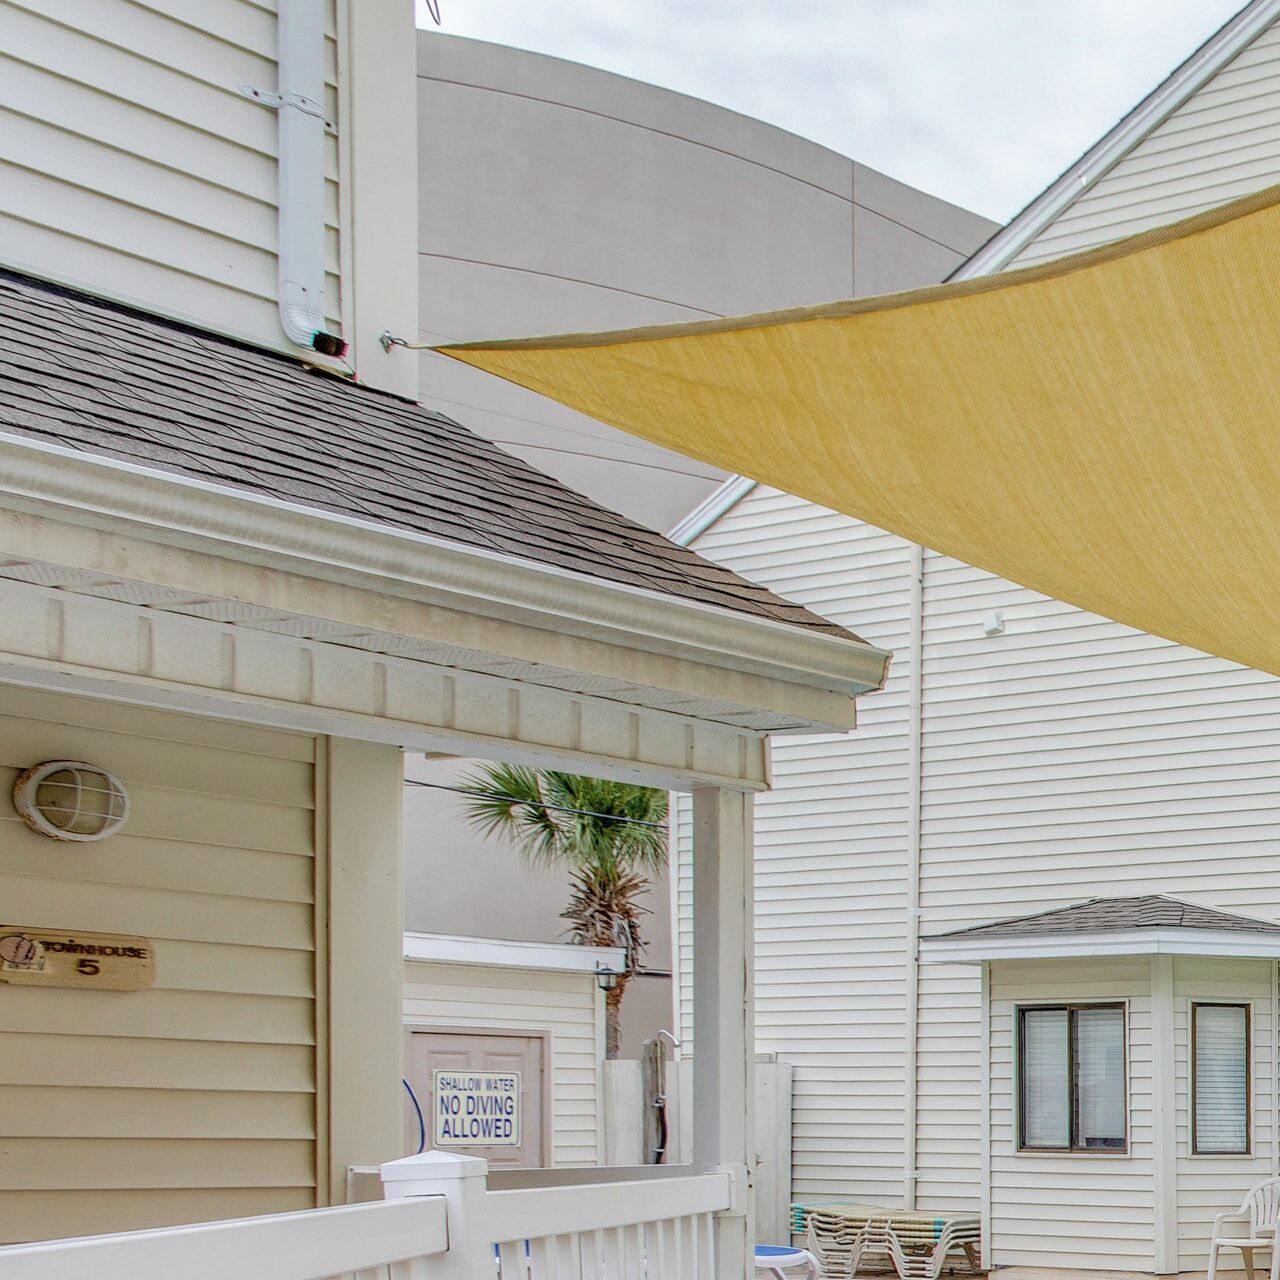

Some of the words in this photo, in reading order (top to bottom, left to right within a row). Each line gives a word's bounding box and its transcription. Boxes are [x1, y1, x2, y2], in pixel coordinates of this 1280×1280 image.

[39, 941, 148, 959] TOWNHOUSE
[77, 959, 100, 976] 5
[440, 1077, 481, 1092] SHALLOW
[485, 1078, 515, 1092] WATER
[440, 1095, 461, 1115] NO
[466, 1096, 514, 1115] DIVING
[441, 1118, 512, 1138] ALLOWED
